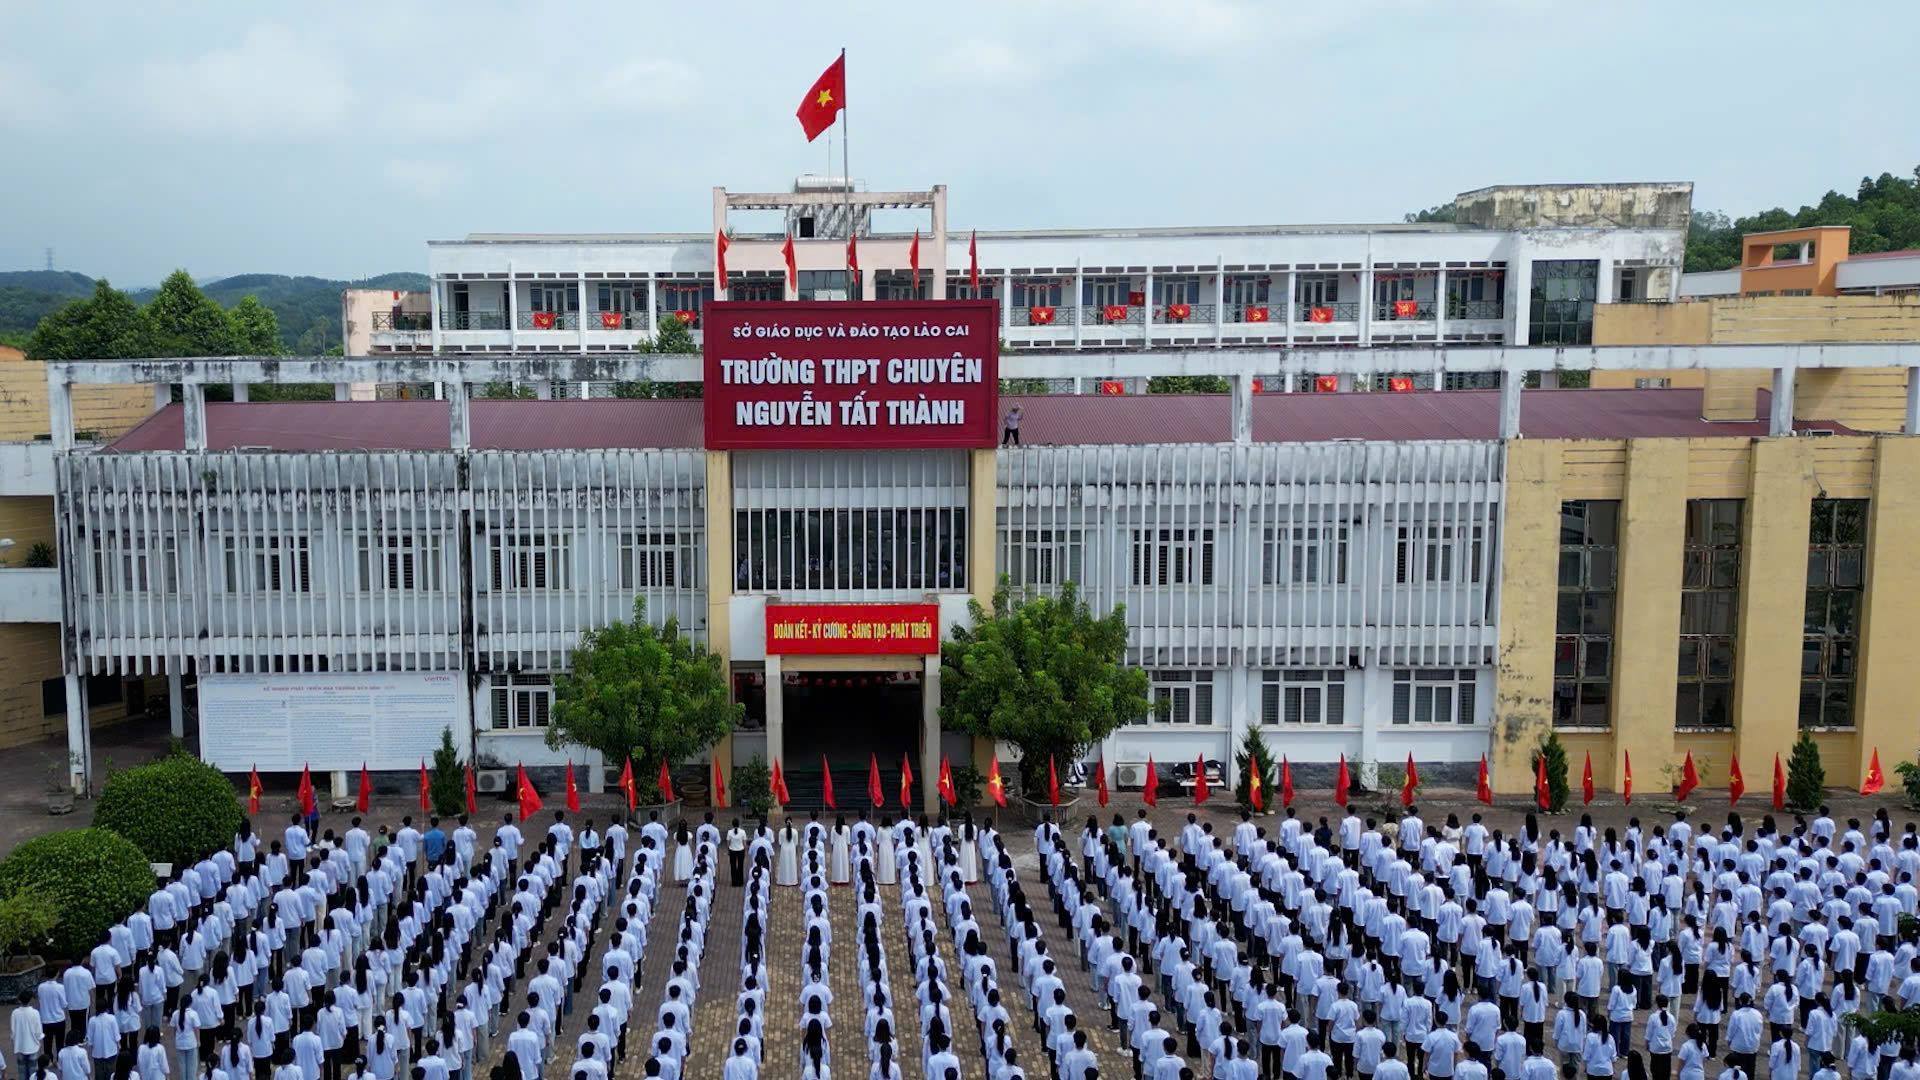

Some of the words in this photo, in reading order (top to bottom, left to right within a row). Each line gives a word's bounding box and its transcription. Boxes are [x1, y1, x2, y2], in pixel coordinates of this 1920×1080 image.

[733, 322, 752, 337] SỞ
[755, 323, 791, 337] GIÁO
[794, 326, 824, 341] DỤC
[827, 323, 846, 337] VÀ
[849, 323, 879, 337] ĐÀO
[883, 325, 910, 340] TẠO
[913, 321, 941, 336] LÀO
[945, 325, 969, 336] CAI
[720, 352, 815, 384] TRƯỜNG
[821, 359, 880, 384] THPT
[887, 351, 982, 383] CHUYÊN
[736, 390, 832, 425] NGUYỄN
[839, 390, 880, 425] TẤT
[886, 393, 964, 424] THÀNH
